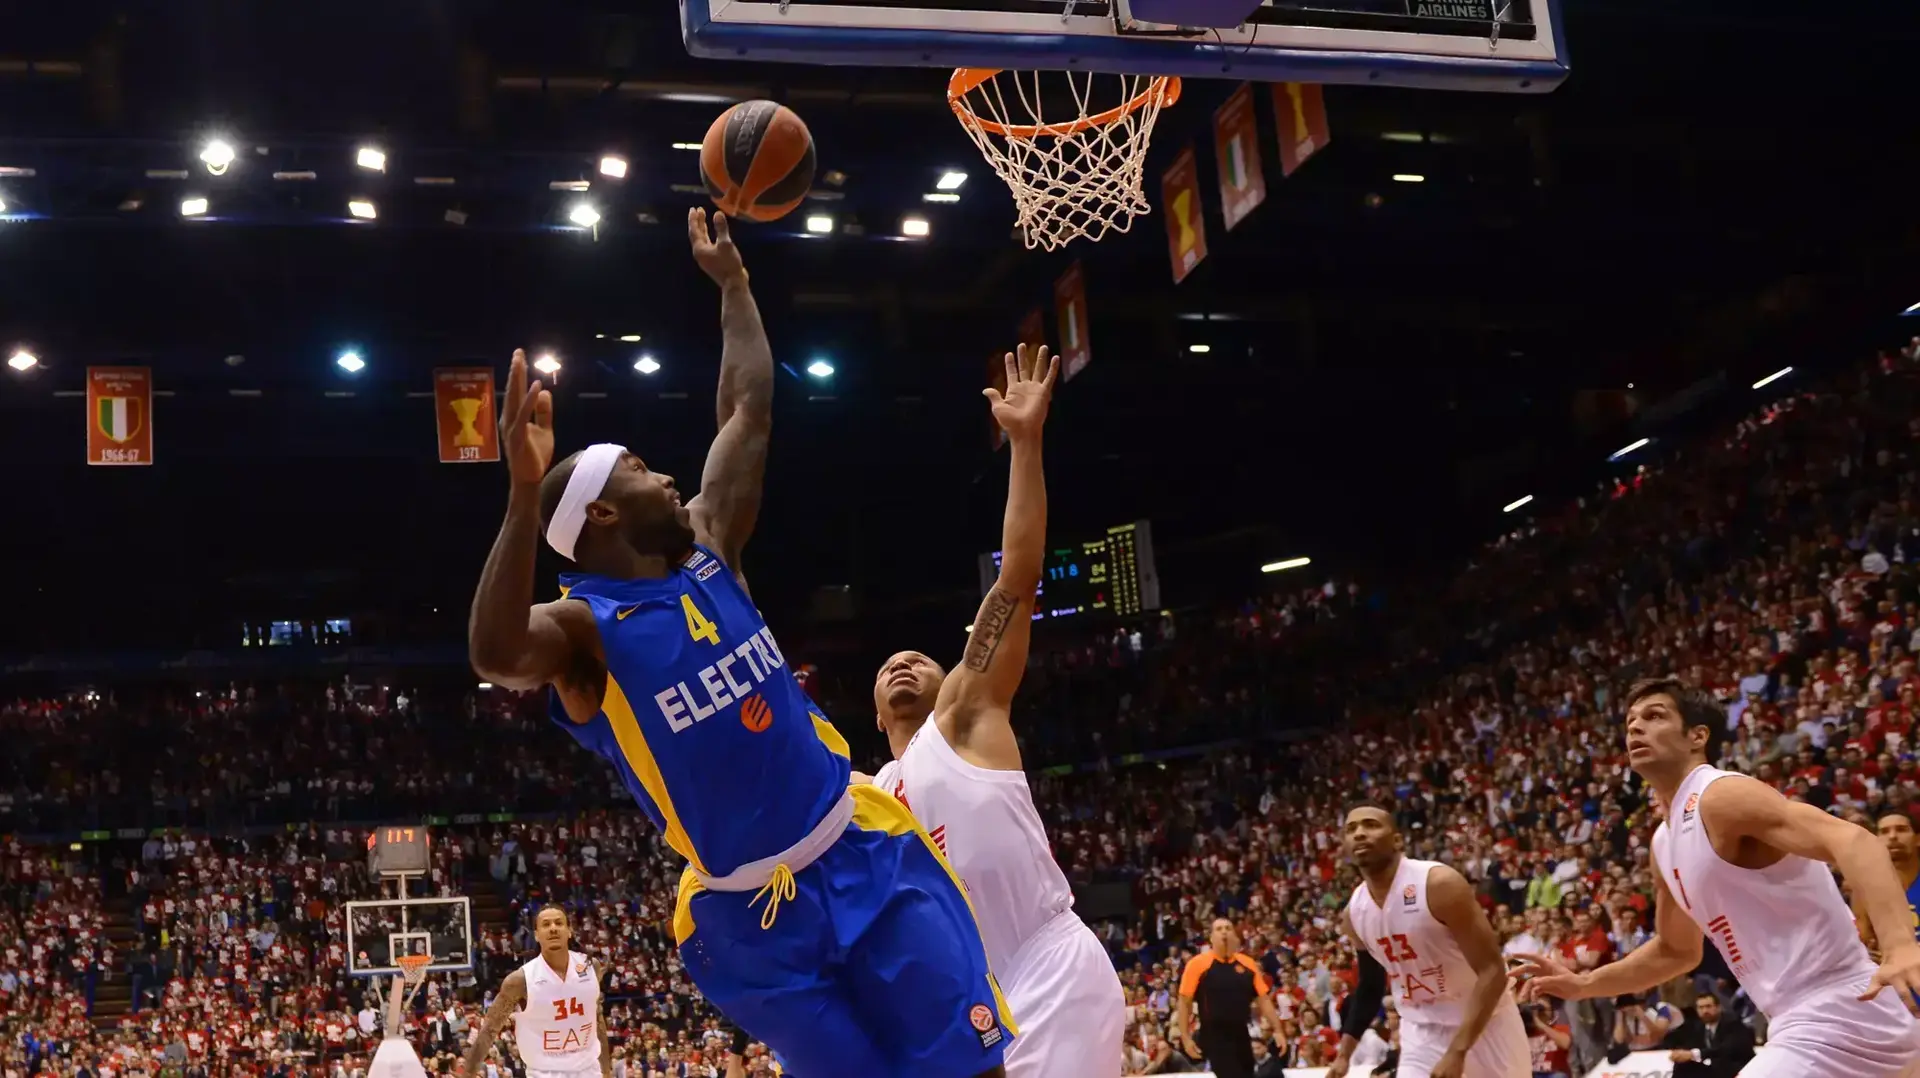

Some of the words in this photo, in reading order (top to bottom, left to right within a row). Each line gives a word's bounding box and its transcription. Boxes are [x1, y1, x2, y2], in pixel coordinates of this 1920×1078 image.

[1417, 3, 1487, 19] AIRLINES
[460, 447, 481, 460] 1971
[680, 593, 721, 646] 4
[1376, 933, 1418, 963] 23
[552, 996, 585, 1021] 34
